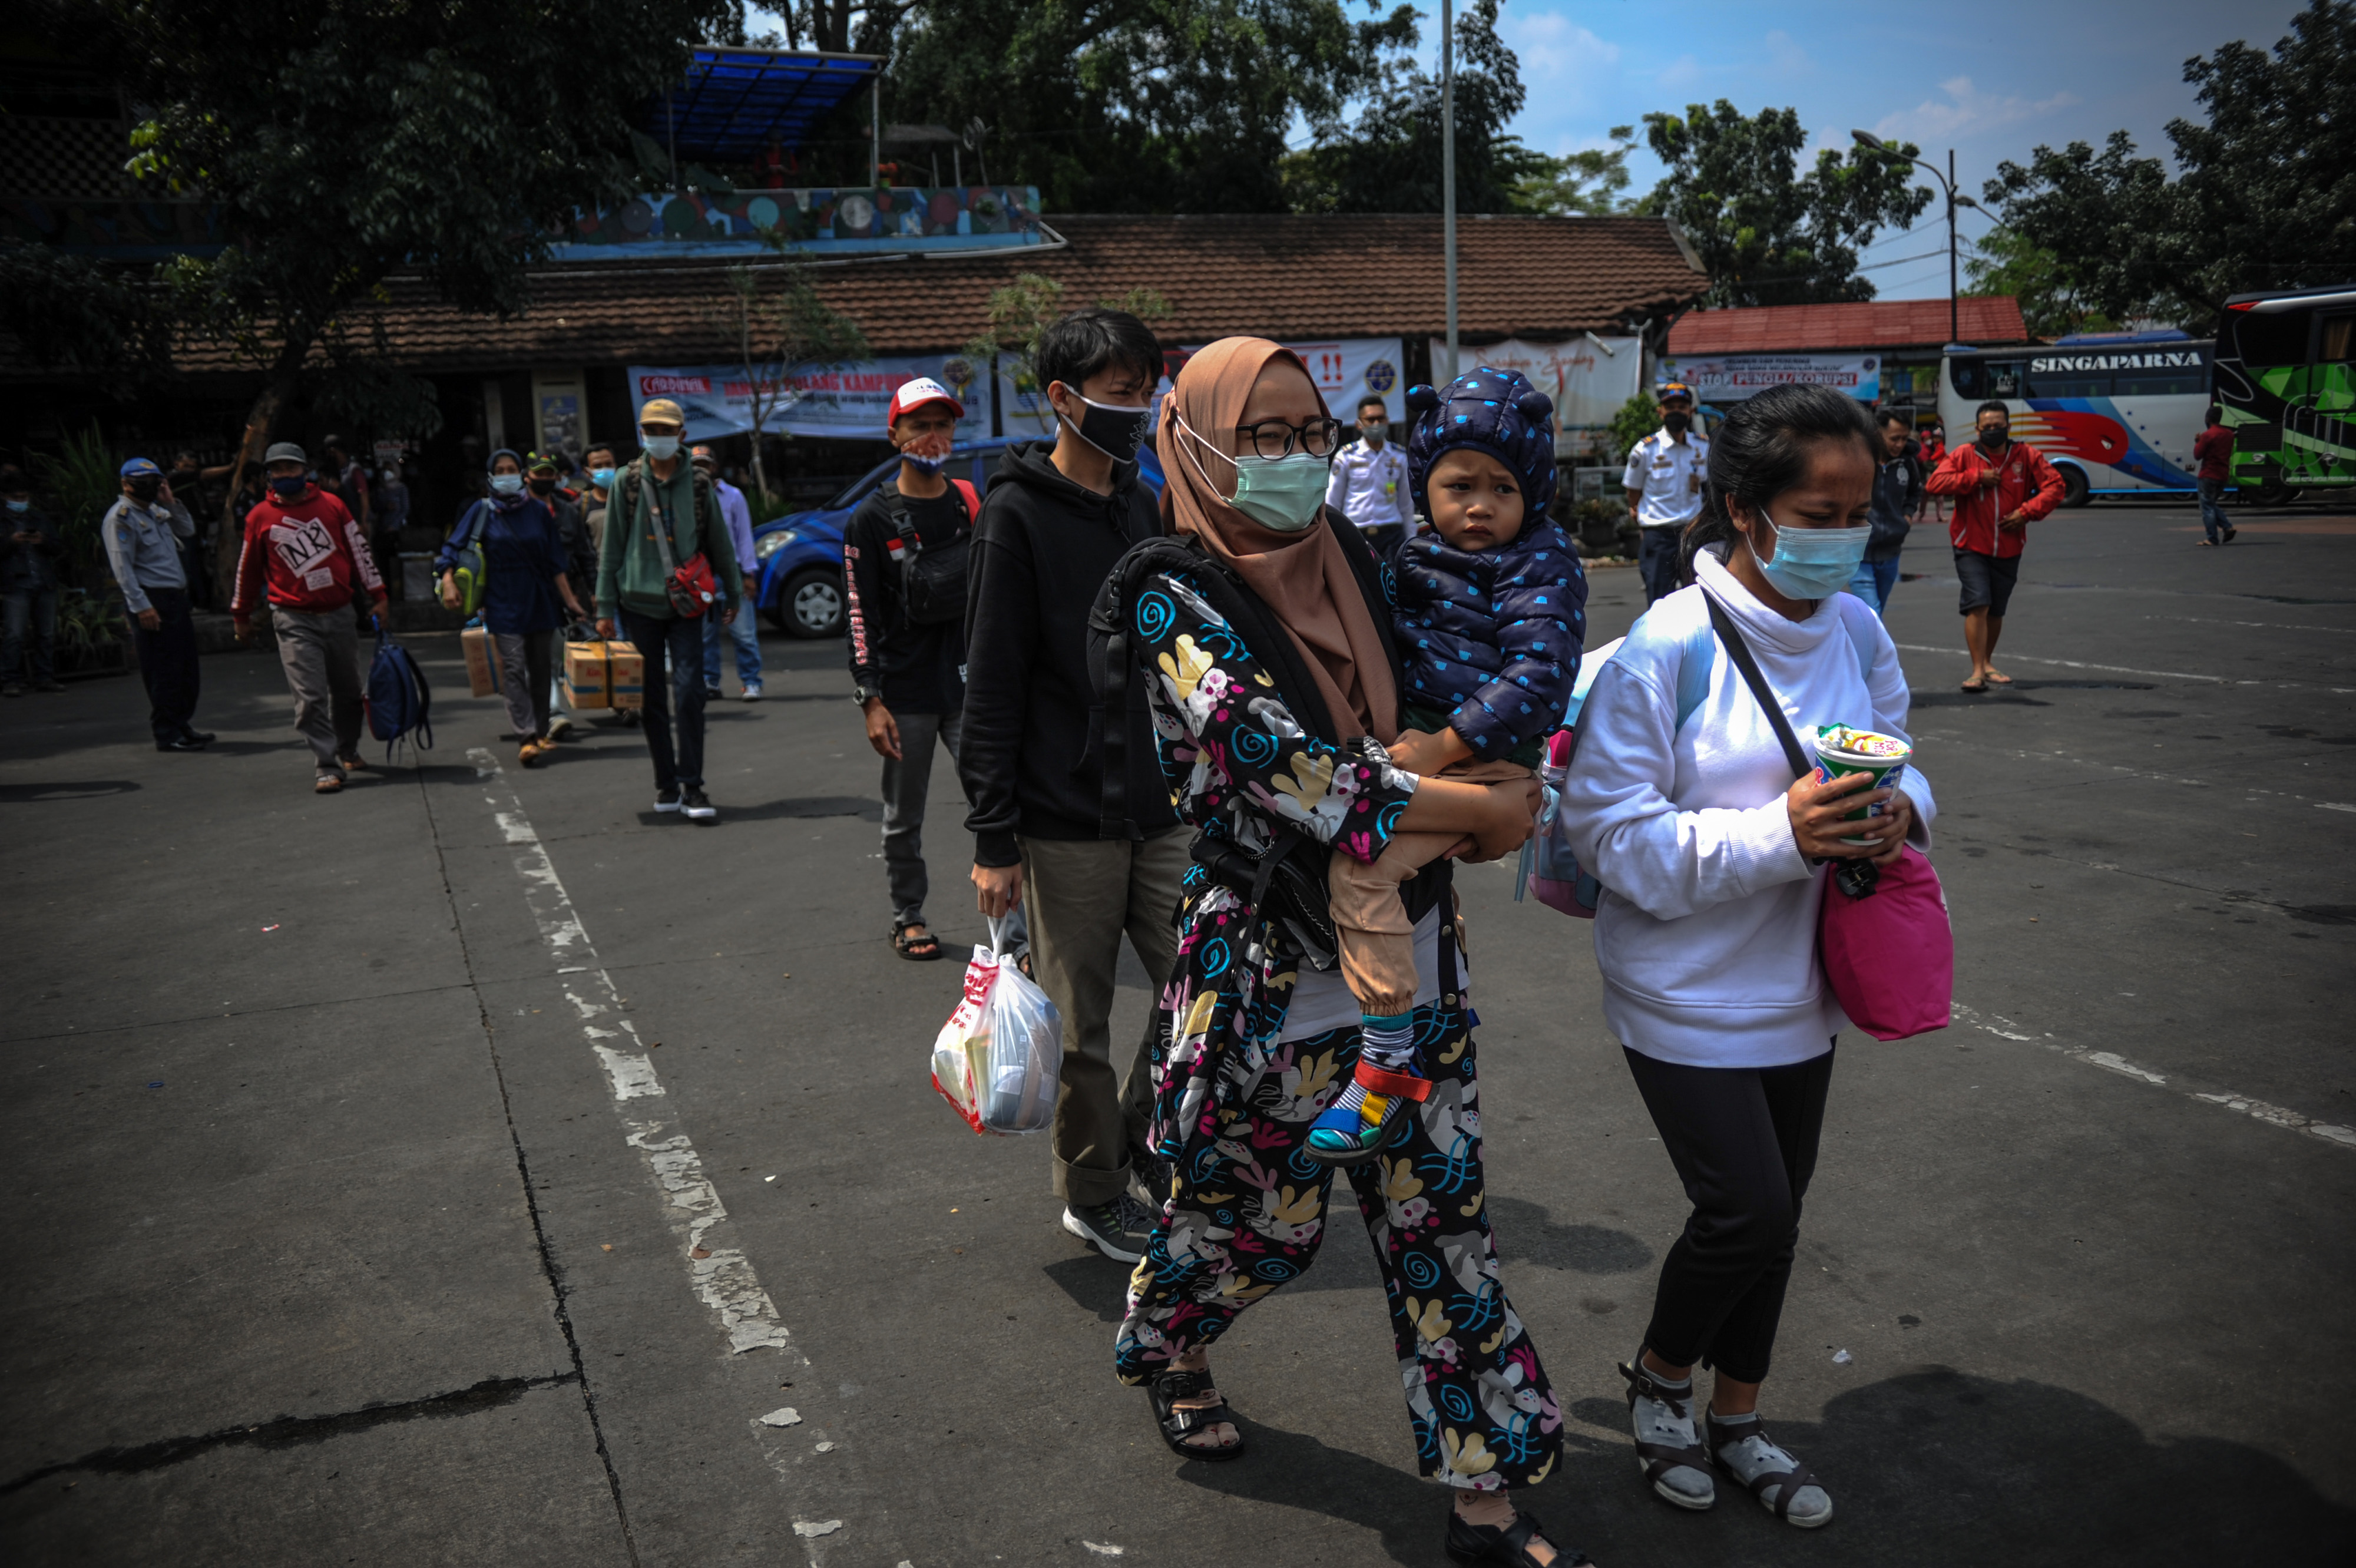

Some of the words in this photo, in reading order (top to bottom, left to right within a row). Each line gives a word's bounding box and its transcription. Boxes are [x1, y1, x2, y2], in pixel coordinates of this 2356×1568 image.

[2031, 352, 2203, 373] SINGAPARNA
[642, 377, 707, 394] CARDINAL
[1699, 373, 1730, 386] STOP
[1885, 740, 1898, 752] POP
